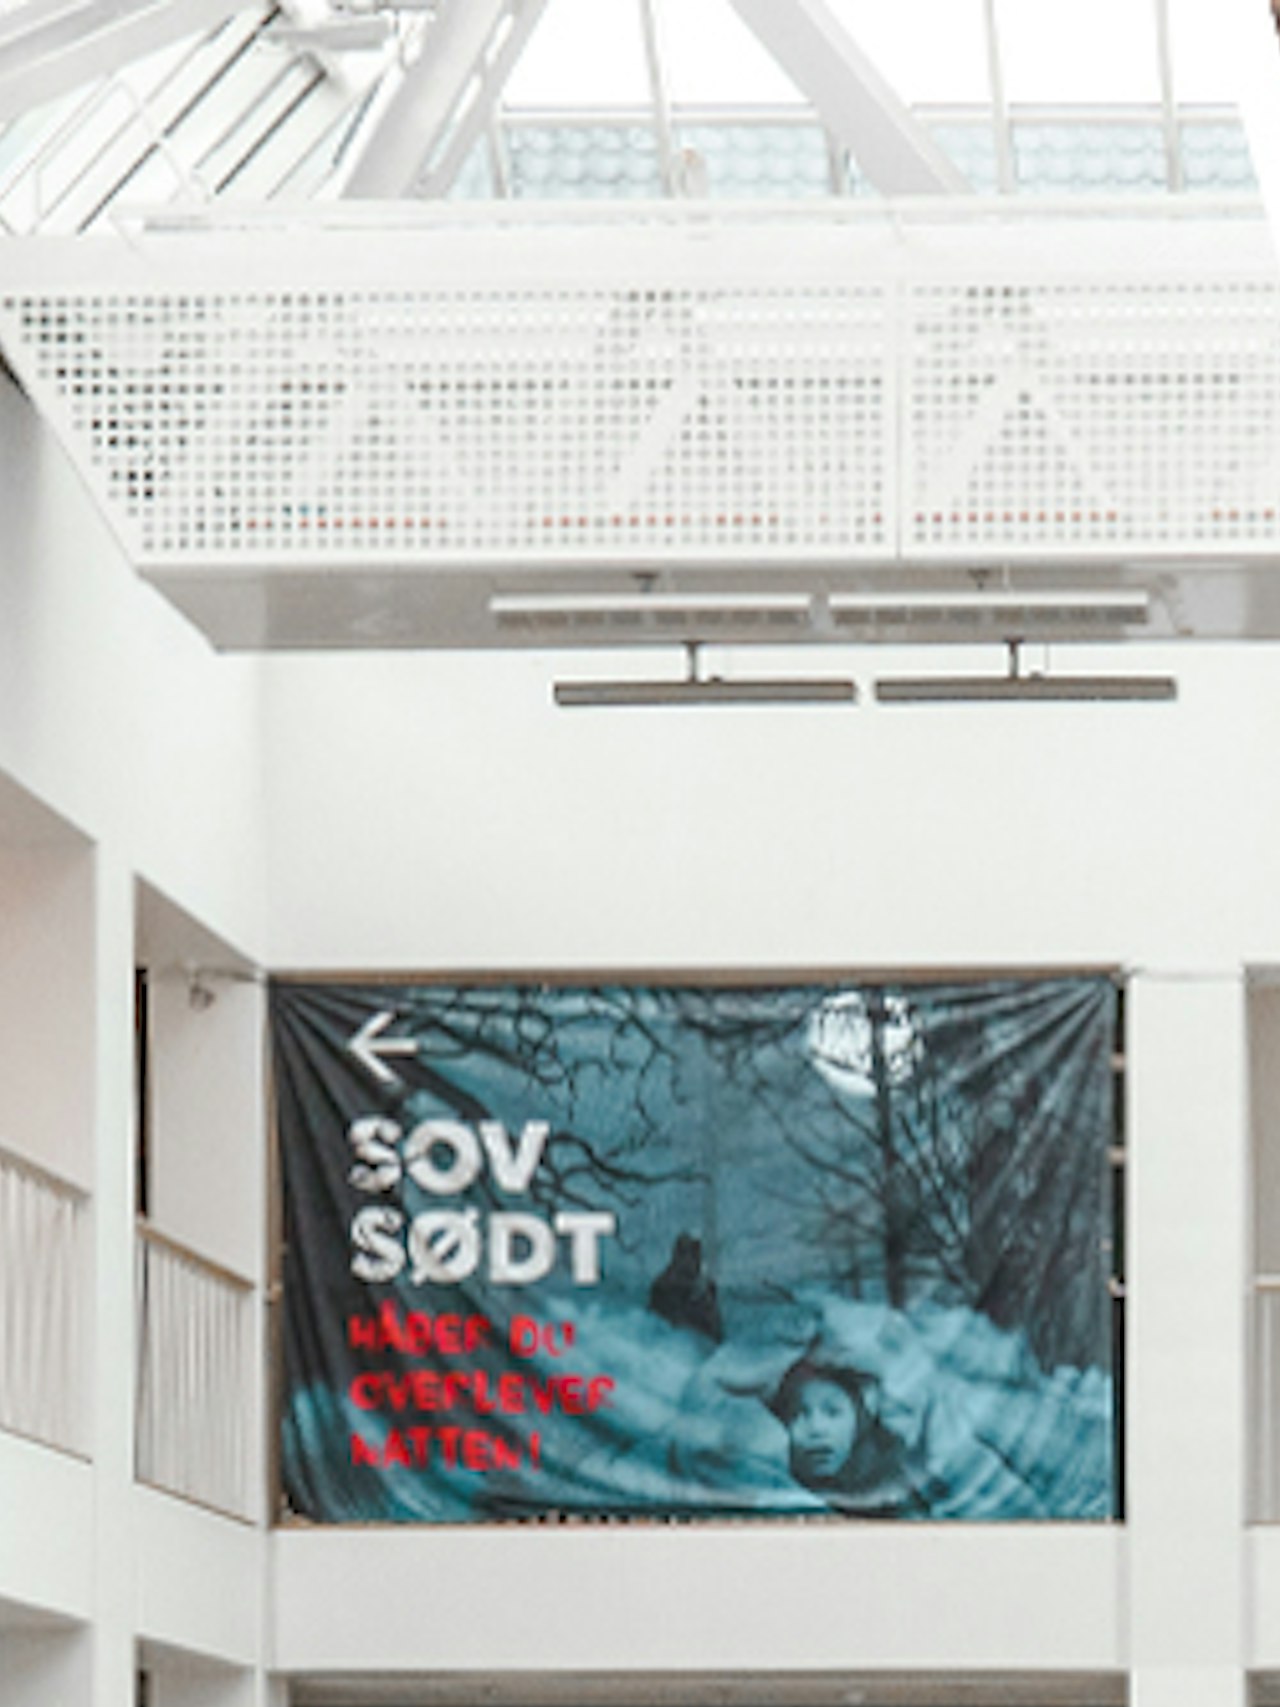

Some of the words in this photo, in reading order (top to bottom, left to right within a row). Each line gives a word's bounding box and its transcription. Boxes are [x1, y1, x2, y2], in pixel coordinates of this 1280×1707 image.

[349, 1117, 550, 1195] SOV
[350, 1205, 616, 1288] SØDT
[510, 1313, 577, 1358] DU
